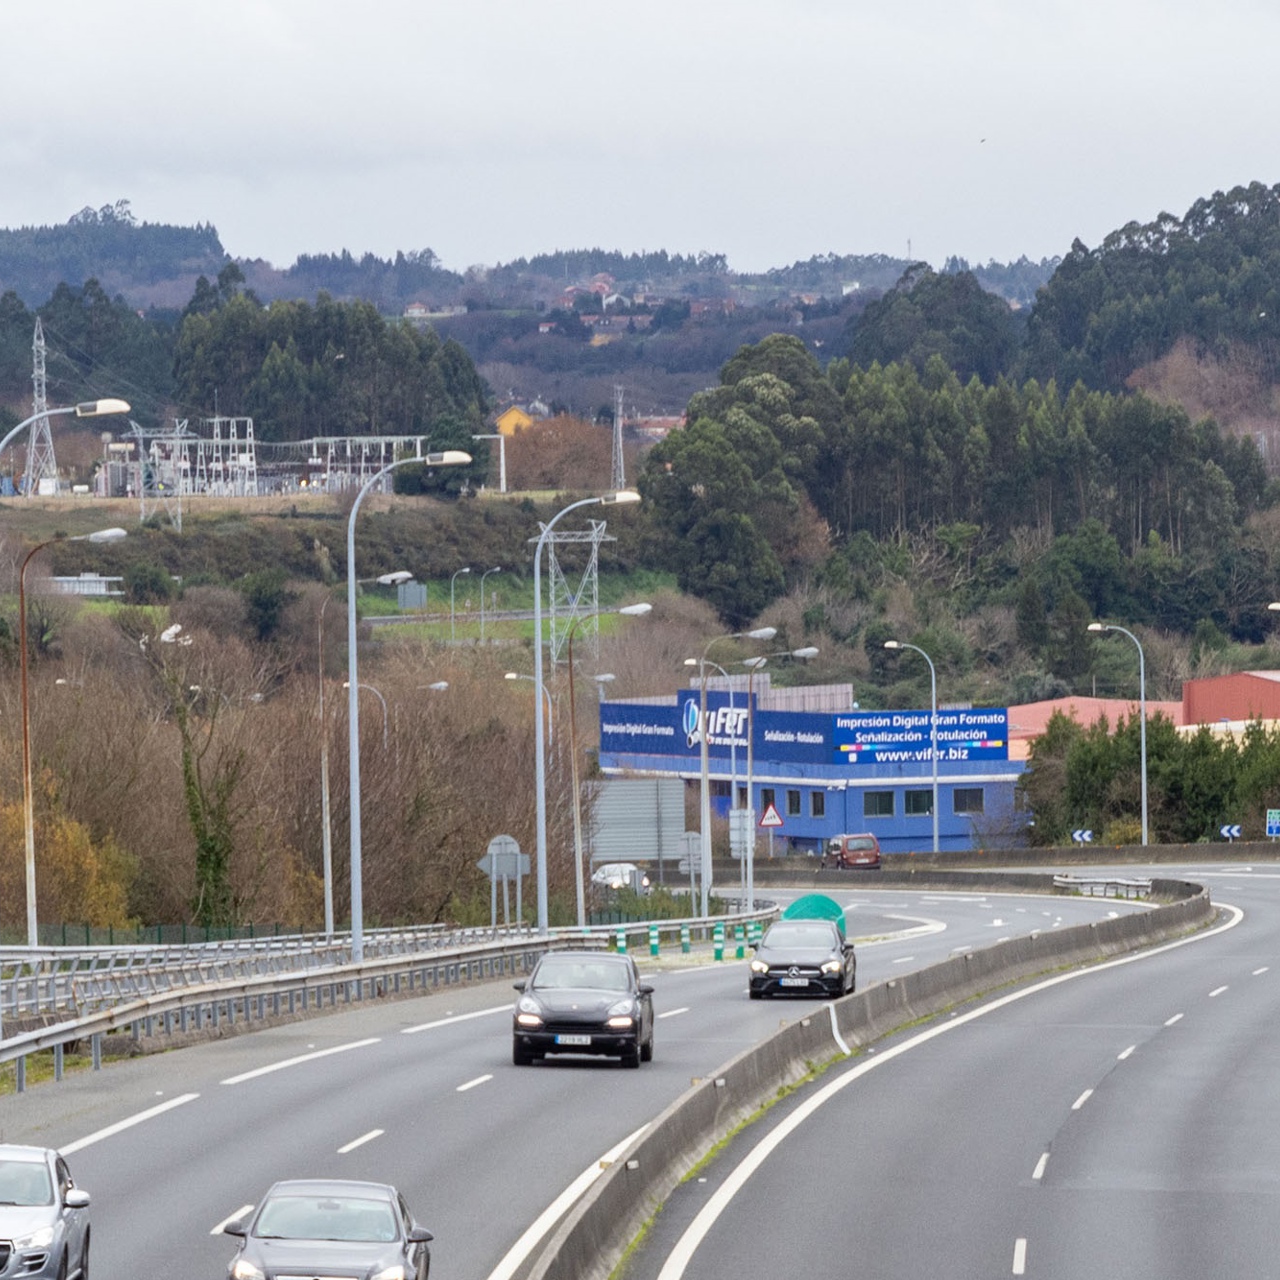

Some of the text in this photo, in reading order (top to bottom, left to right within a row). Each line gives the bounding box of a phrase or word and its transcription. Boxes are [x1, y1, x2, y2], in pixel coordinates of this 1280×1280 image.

[837, 713, 1005, 730] Impresión Digital Gran Formato
[855, 731, 922, 743] Señalización
